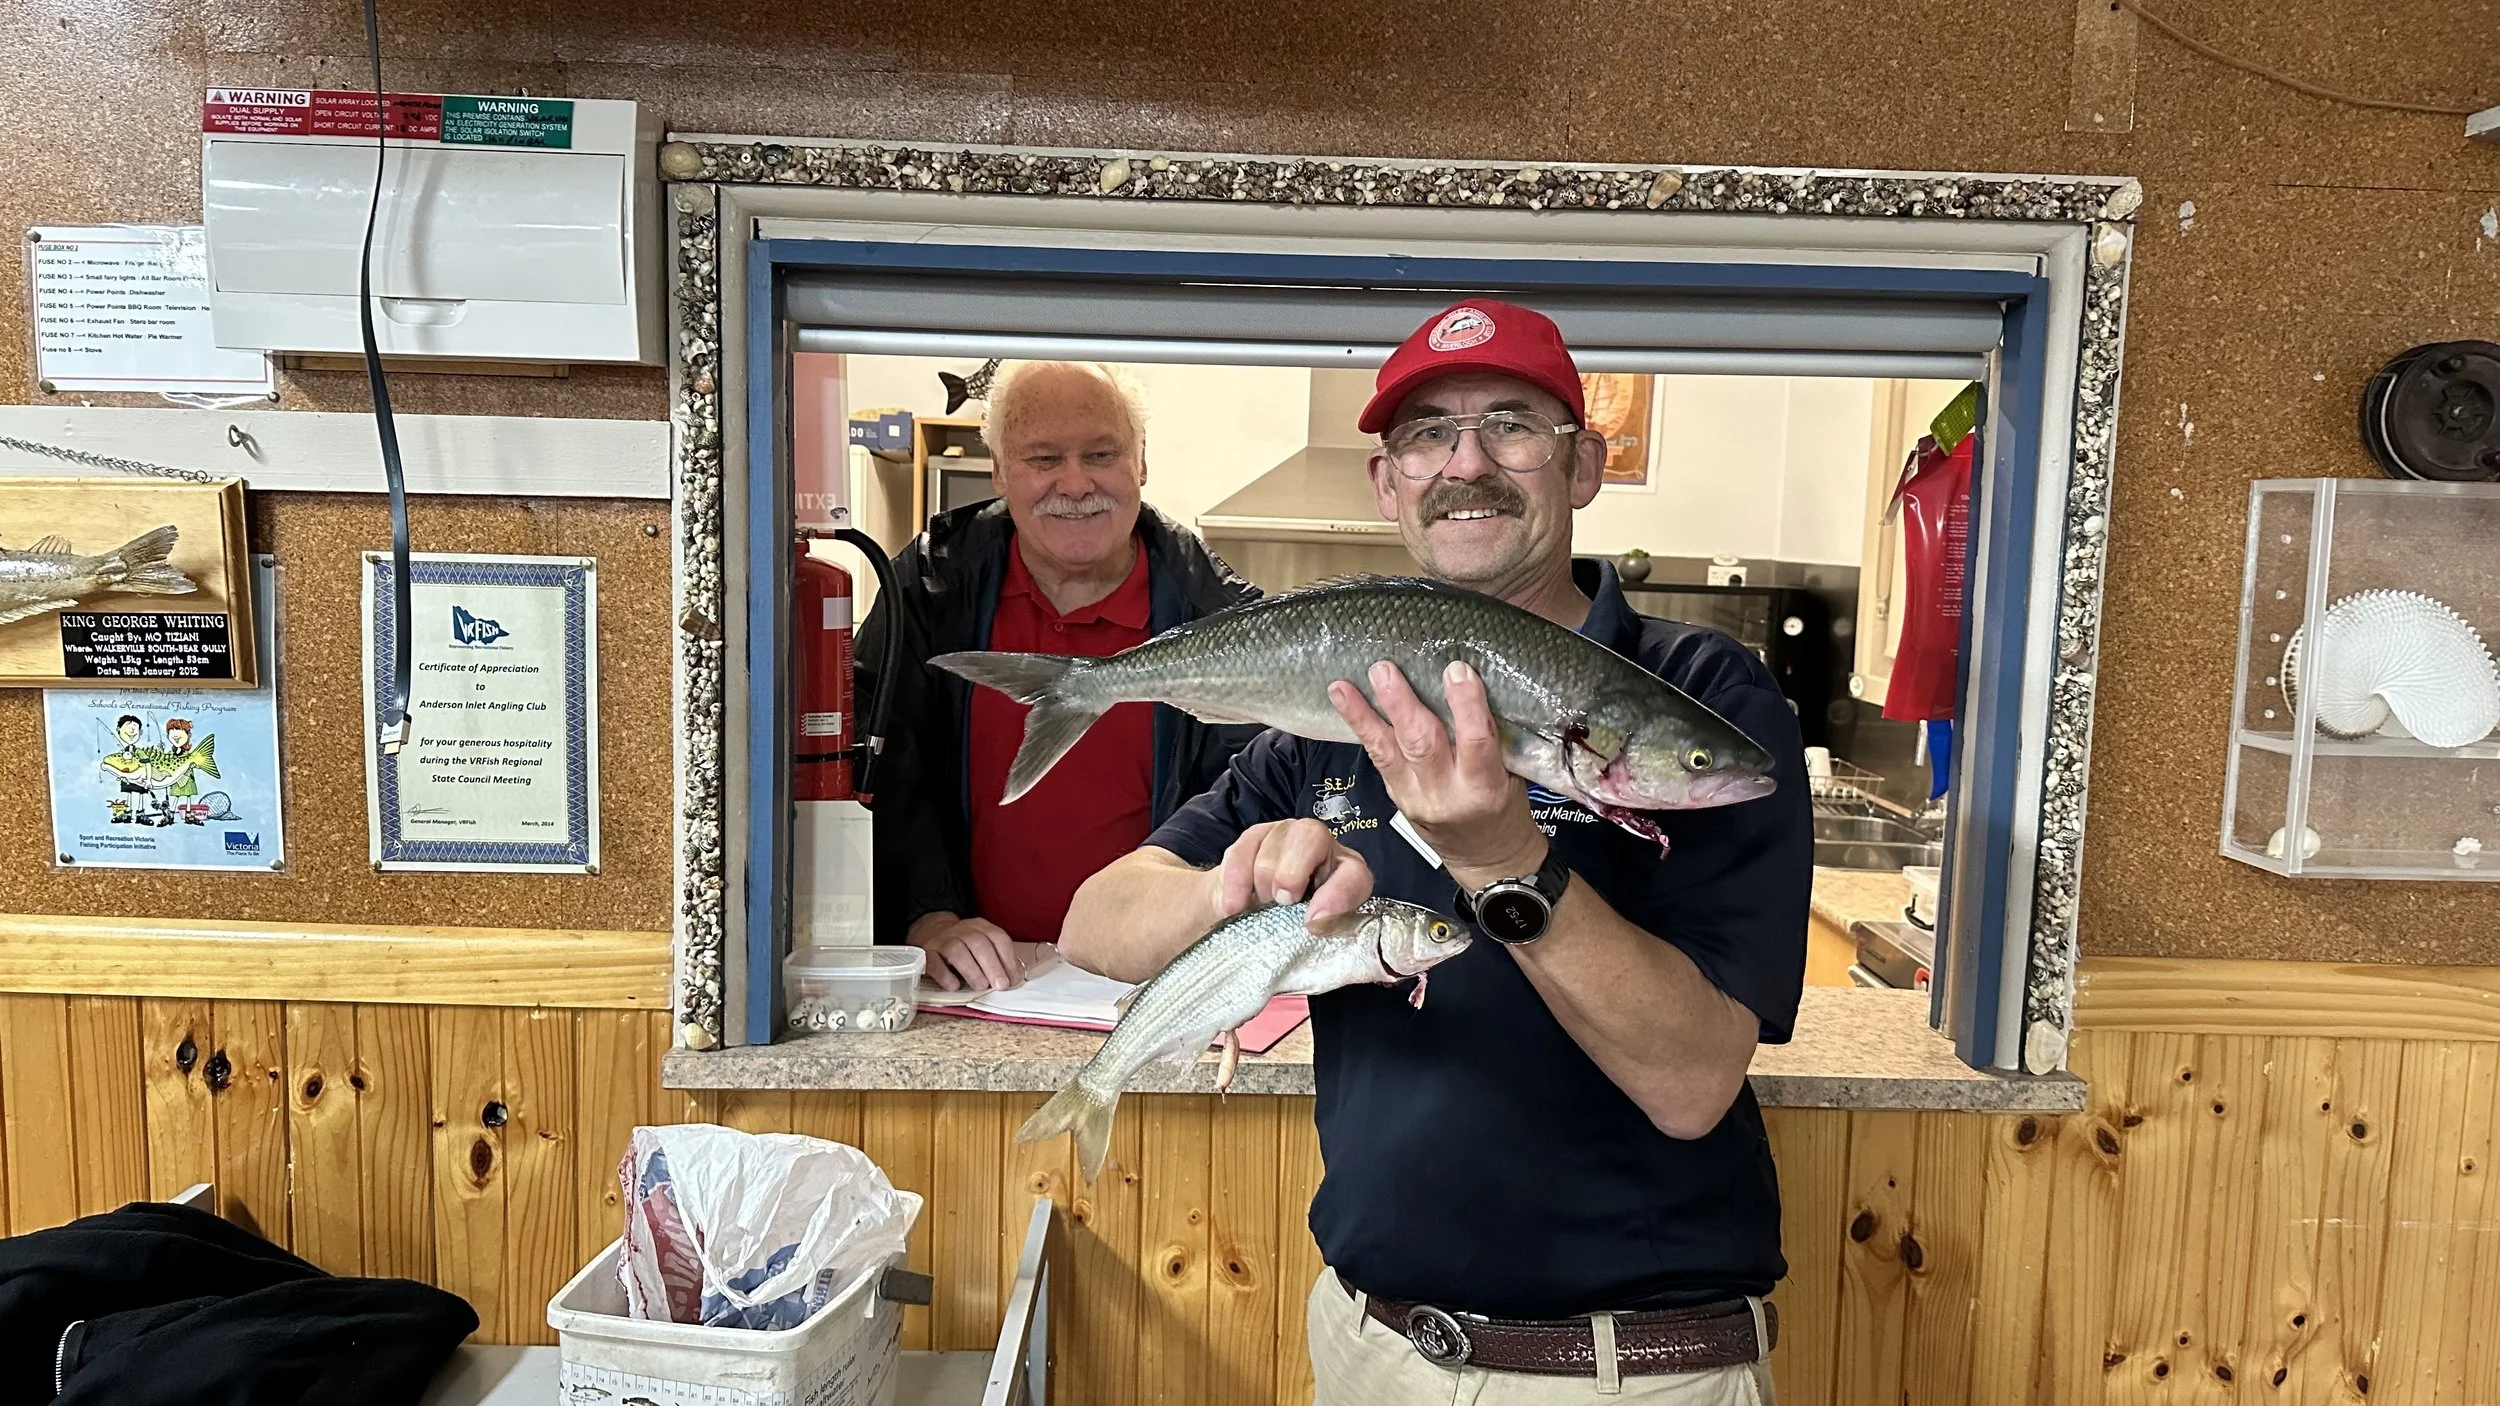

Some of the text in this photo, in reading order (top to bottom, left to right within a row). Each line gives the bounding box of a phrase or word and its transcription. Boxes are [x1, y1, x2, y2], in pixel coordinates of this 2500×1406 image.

[228, 91, 306, 105] WARNING
[361, 99, 391, 107] LOCAED
[229, 106, 285, 115] DUAL SUPPLY
[477, 101, 539, 114] WARNING
[314, 109, 332, 117] OPEN
[334, 110, 359, 118] CIRCUIT
[446, 111, 461, 119] THIS
[462, 112, 491, 120] PREMISE
[492, 113, 525, 122] CONTAINS
[313, 121, 438, 134] SHORT CIRCUIT DC AMPS
[456, 120, 498, 128] ELECTRICITY
[498, 121, 540, 130] GENERATION
[540, 123, 568, 131] SYSTEM
[452, 133, 483, 141] LOCATED
[460, 127, 482, 135] SOLAR
[483, 128, 518, 136] ISOLATION
[519, 129, 545, 137] SWITCH
[104, 274, 117, 282] fairy
[62, 615, 225, 628] KING GEORGE WHITING
[90, 632, 200, 643] Caught By: MO TIZIANI
[64, 644, 227, 653] Where: WALKERVILLE SOUTH-BEAR GULLY
[84, 655, 210, 665] Weight: 1.5kg Length: 53cm
[97, 667, 199, 677] Date: 15th January 2012
[418, 662, 540, 674] Certificate of Appreciation
[475, 683, 486, 691] to
[87, 699, 237, 715] Schools Recreational Fishing Program
[419, 700, 547, 712] Anderson Inlet Angling Club
[419, 737, 553, 750] for your generous hospitality
[419, 756, 543, 767] during the VRFish Regional
[431, 774, 532, 786] State Council Meeting
[1549, 806, 1599, 824] Marine
[79, 841, 99, 849] Fishing
[100, 842, 133, 850] Participation
[225, 842, 259, 851] Victoria
[1505, 905, 1528, 929] 17:52
[804, 1388, 819, 1406] Fish
[819, 1368, 842, 1393] length
[842, 1353, 856, 1373] ruler
